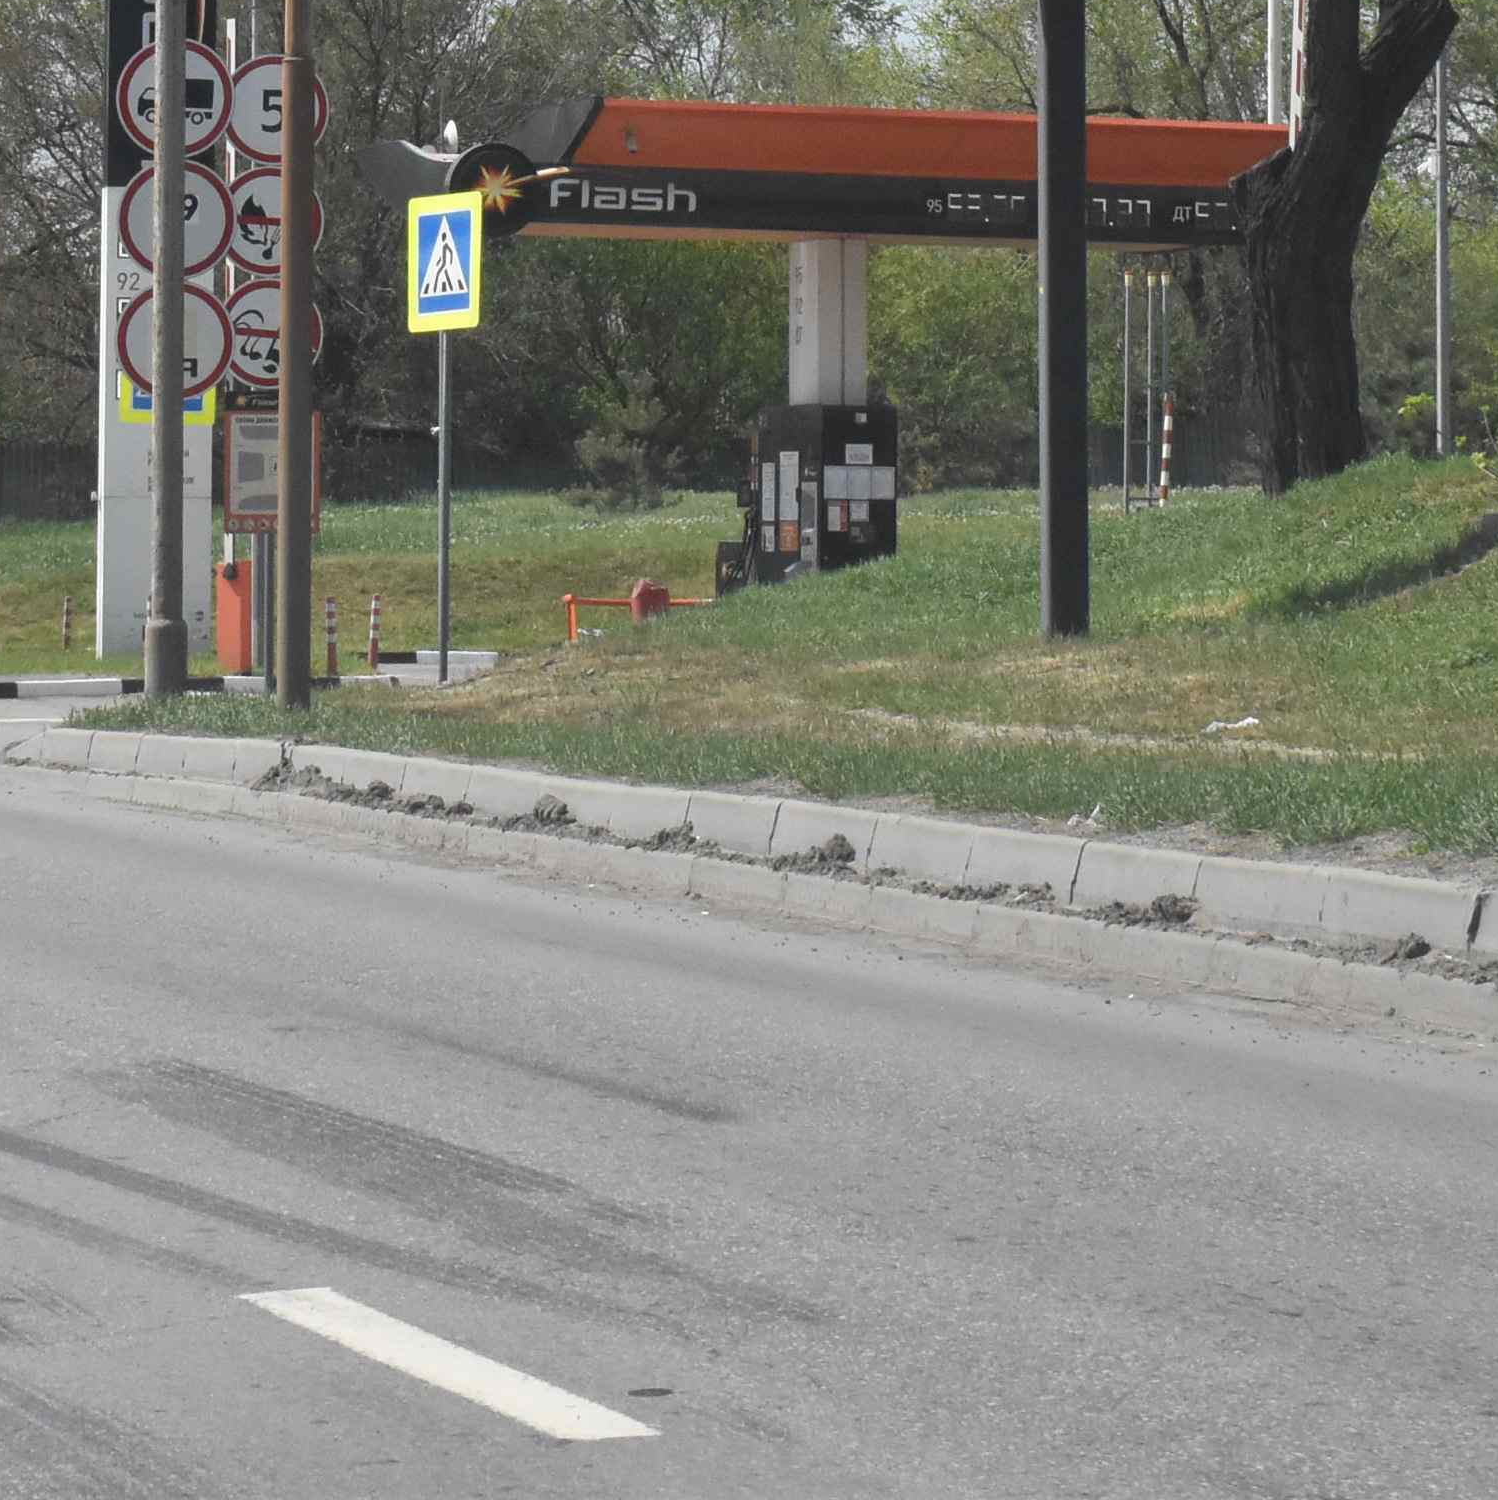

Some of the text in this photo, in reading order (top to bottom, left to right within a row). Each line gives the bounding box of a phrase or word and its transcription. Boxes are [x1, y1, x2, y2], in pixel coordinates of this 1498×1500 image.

[550, 178, 697, 212] Flash
[926, 199, 943, 213] 95
[1172, 206, 1192, 222] ДТ
[116, 272, 141, 291] 92
